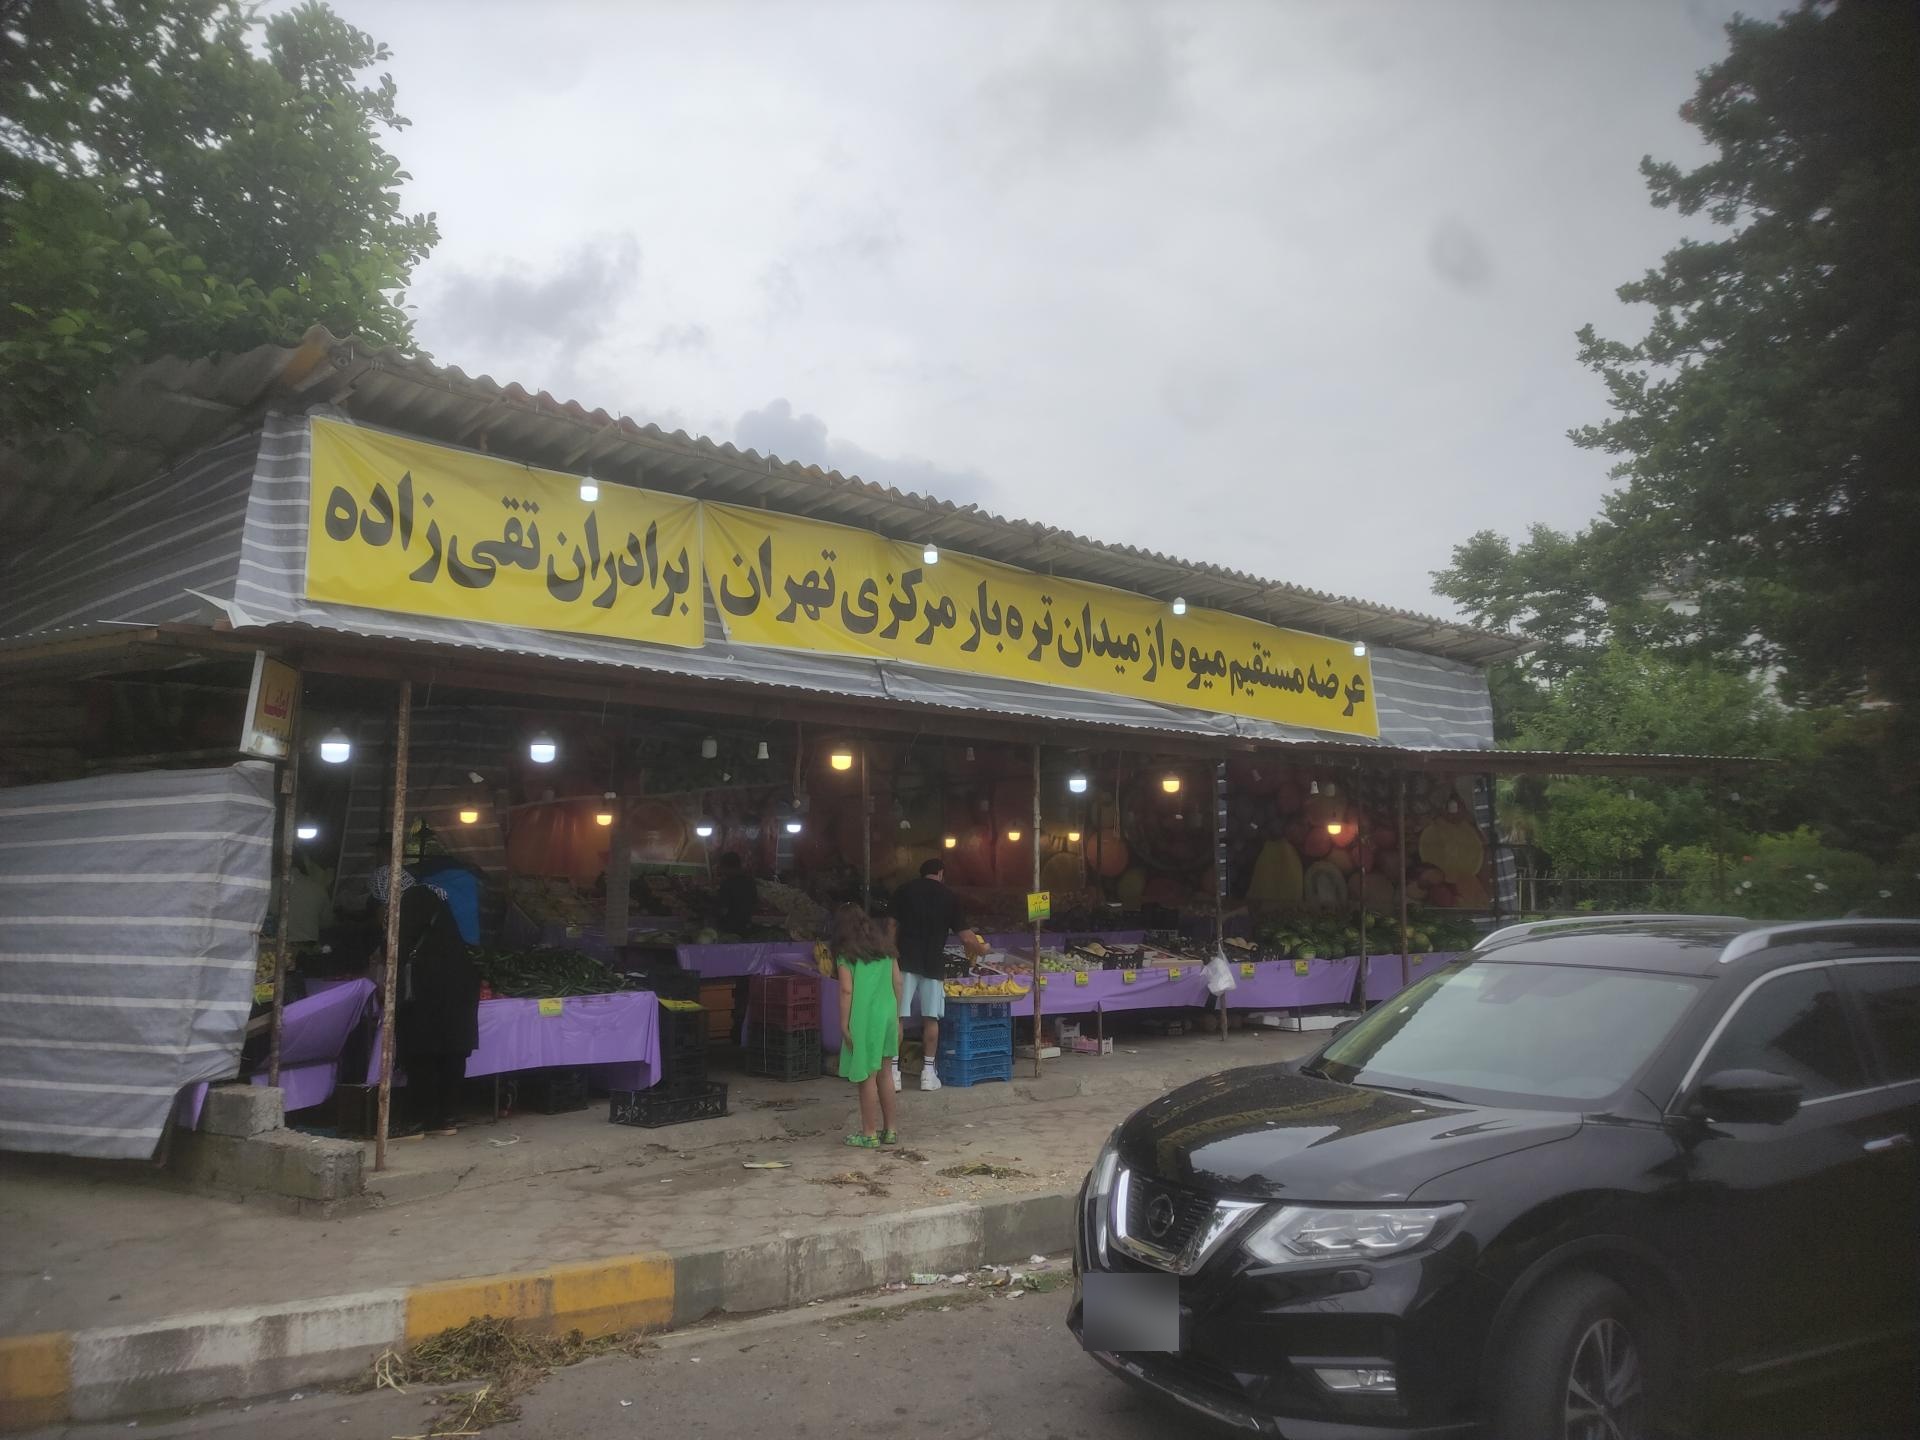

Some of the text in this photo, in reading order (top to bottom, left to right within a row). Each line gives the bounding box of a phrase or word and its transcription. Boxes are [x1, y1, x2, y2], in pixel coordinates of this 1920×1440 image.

[547, 509, 690, 617] برادران
[720, 535, 837, 624] تهران
[840, 568, 957, 645] مرکزی
[1057, 602, 1141, 675] میدان
[1142, 618, 1165, 683] از
[1170, 637, 1227, 690] میوه
[1229, 641, 1305, 697] مستقیم
[1307, 657, 1366, 717] عرضه
